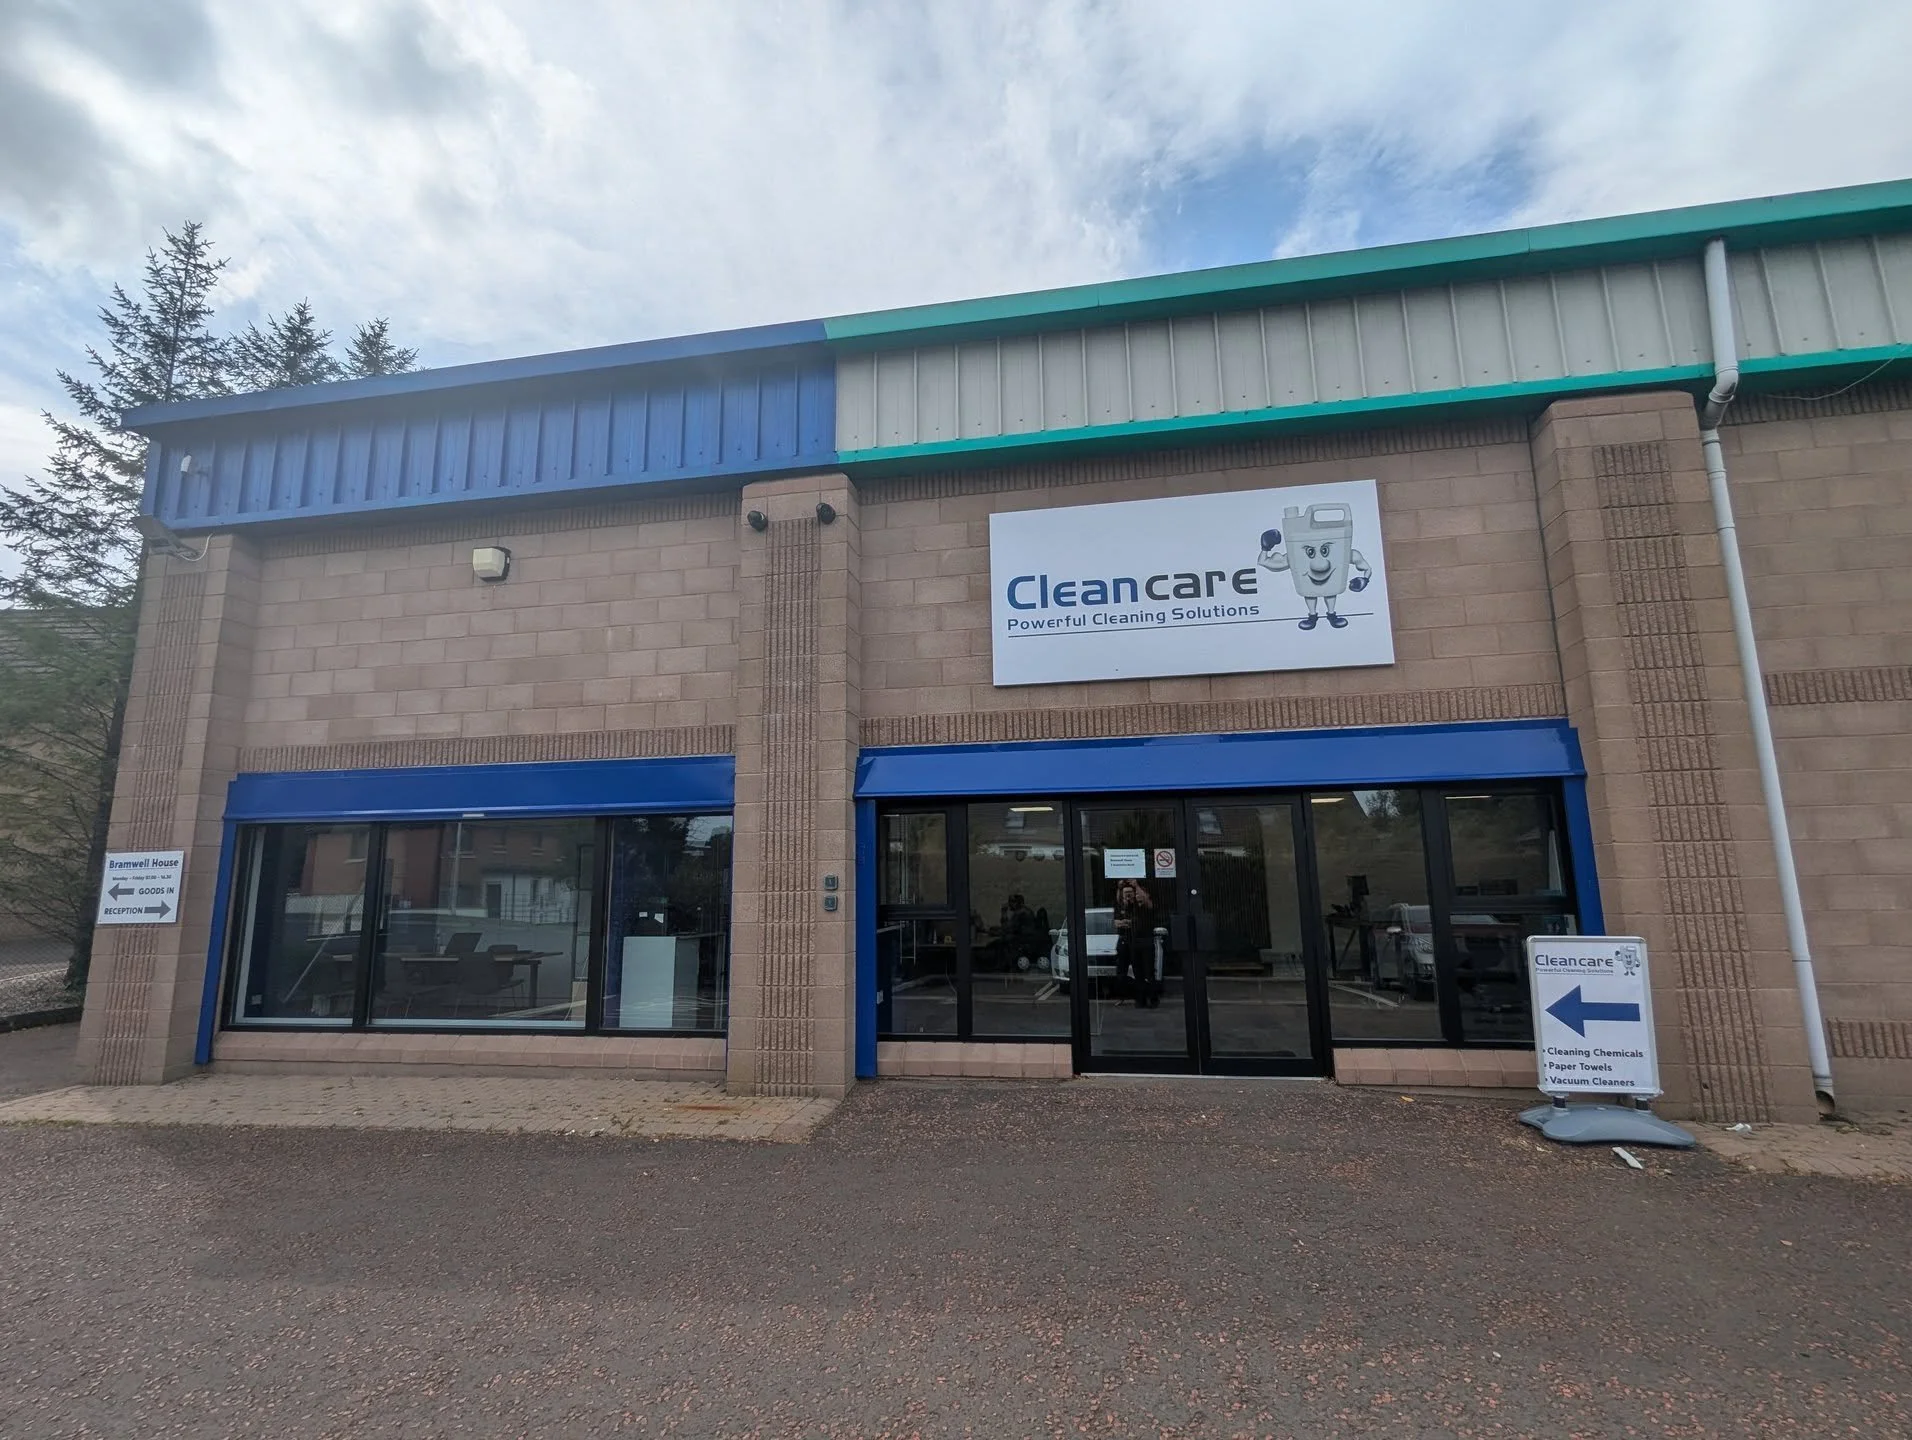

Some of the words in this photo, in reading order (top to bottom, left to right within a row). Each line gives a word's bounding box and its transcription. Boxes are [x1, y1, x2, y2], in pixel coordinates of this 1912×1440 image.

[1006, 567, 1259, 611] Cleancare
[1007, 614, 1087, 631] Powerful
[1092, 609, 1166, 627] Cleaning
[1171, 603, 1260, 620] Solutions
[109, 858, 150, 869] Bramwell
[151, 858, 179, 868] House
[138, 887, 165, 895] GOODS
[104, 907, 143, 915] RECEPTION
[1535, 954, 1614, 968] Cleancare
[1547, 1047, 1591, 1058] Cleaning
[1593, 1048, 1644, 1058] Chemicals
[1548, 1061, 1577, 1071] Paper
[1579, 1062, 1613, 1072] Towels
[1549, 1076, 1590, 1086] Vacuum
[1592, 1077, 1635, 1087] Cleaners
